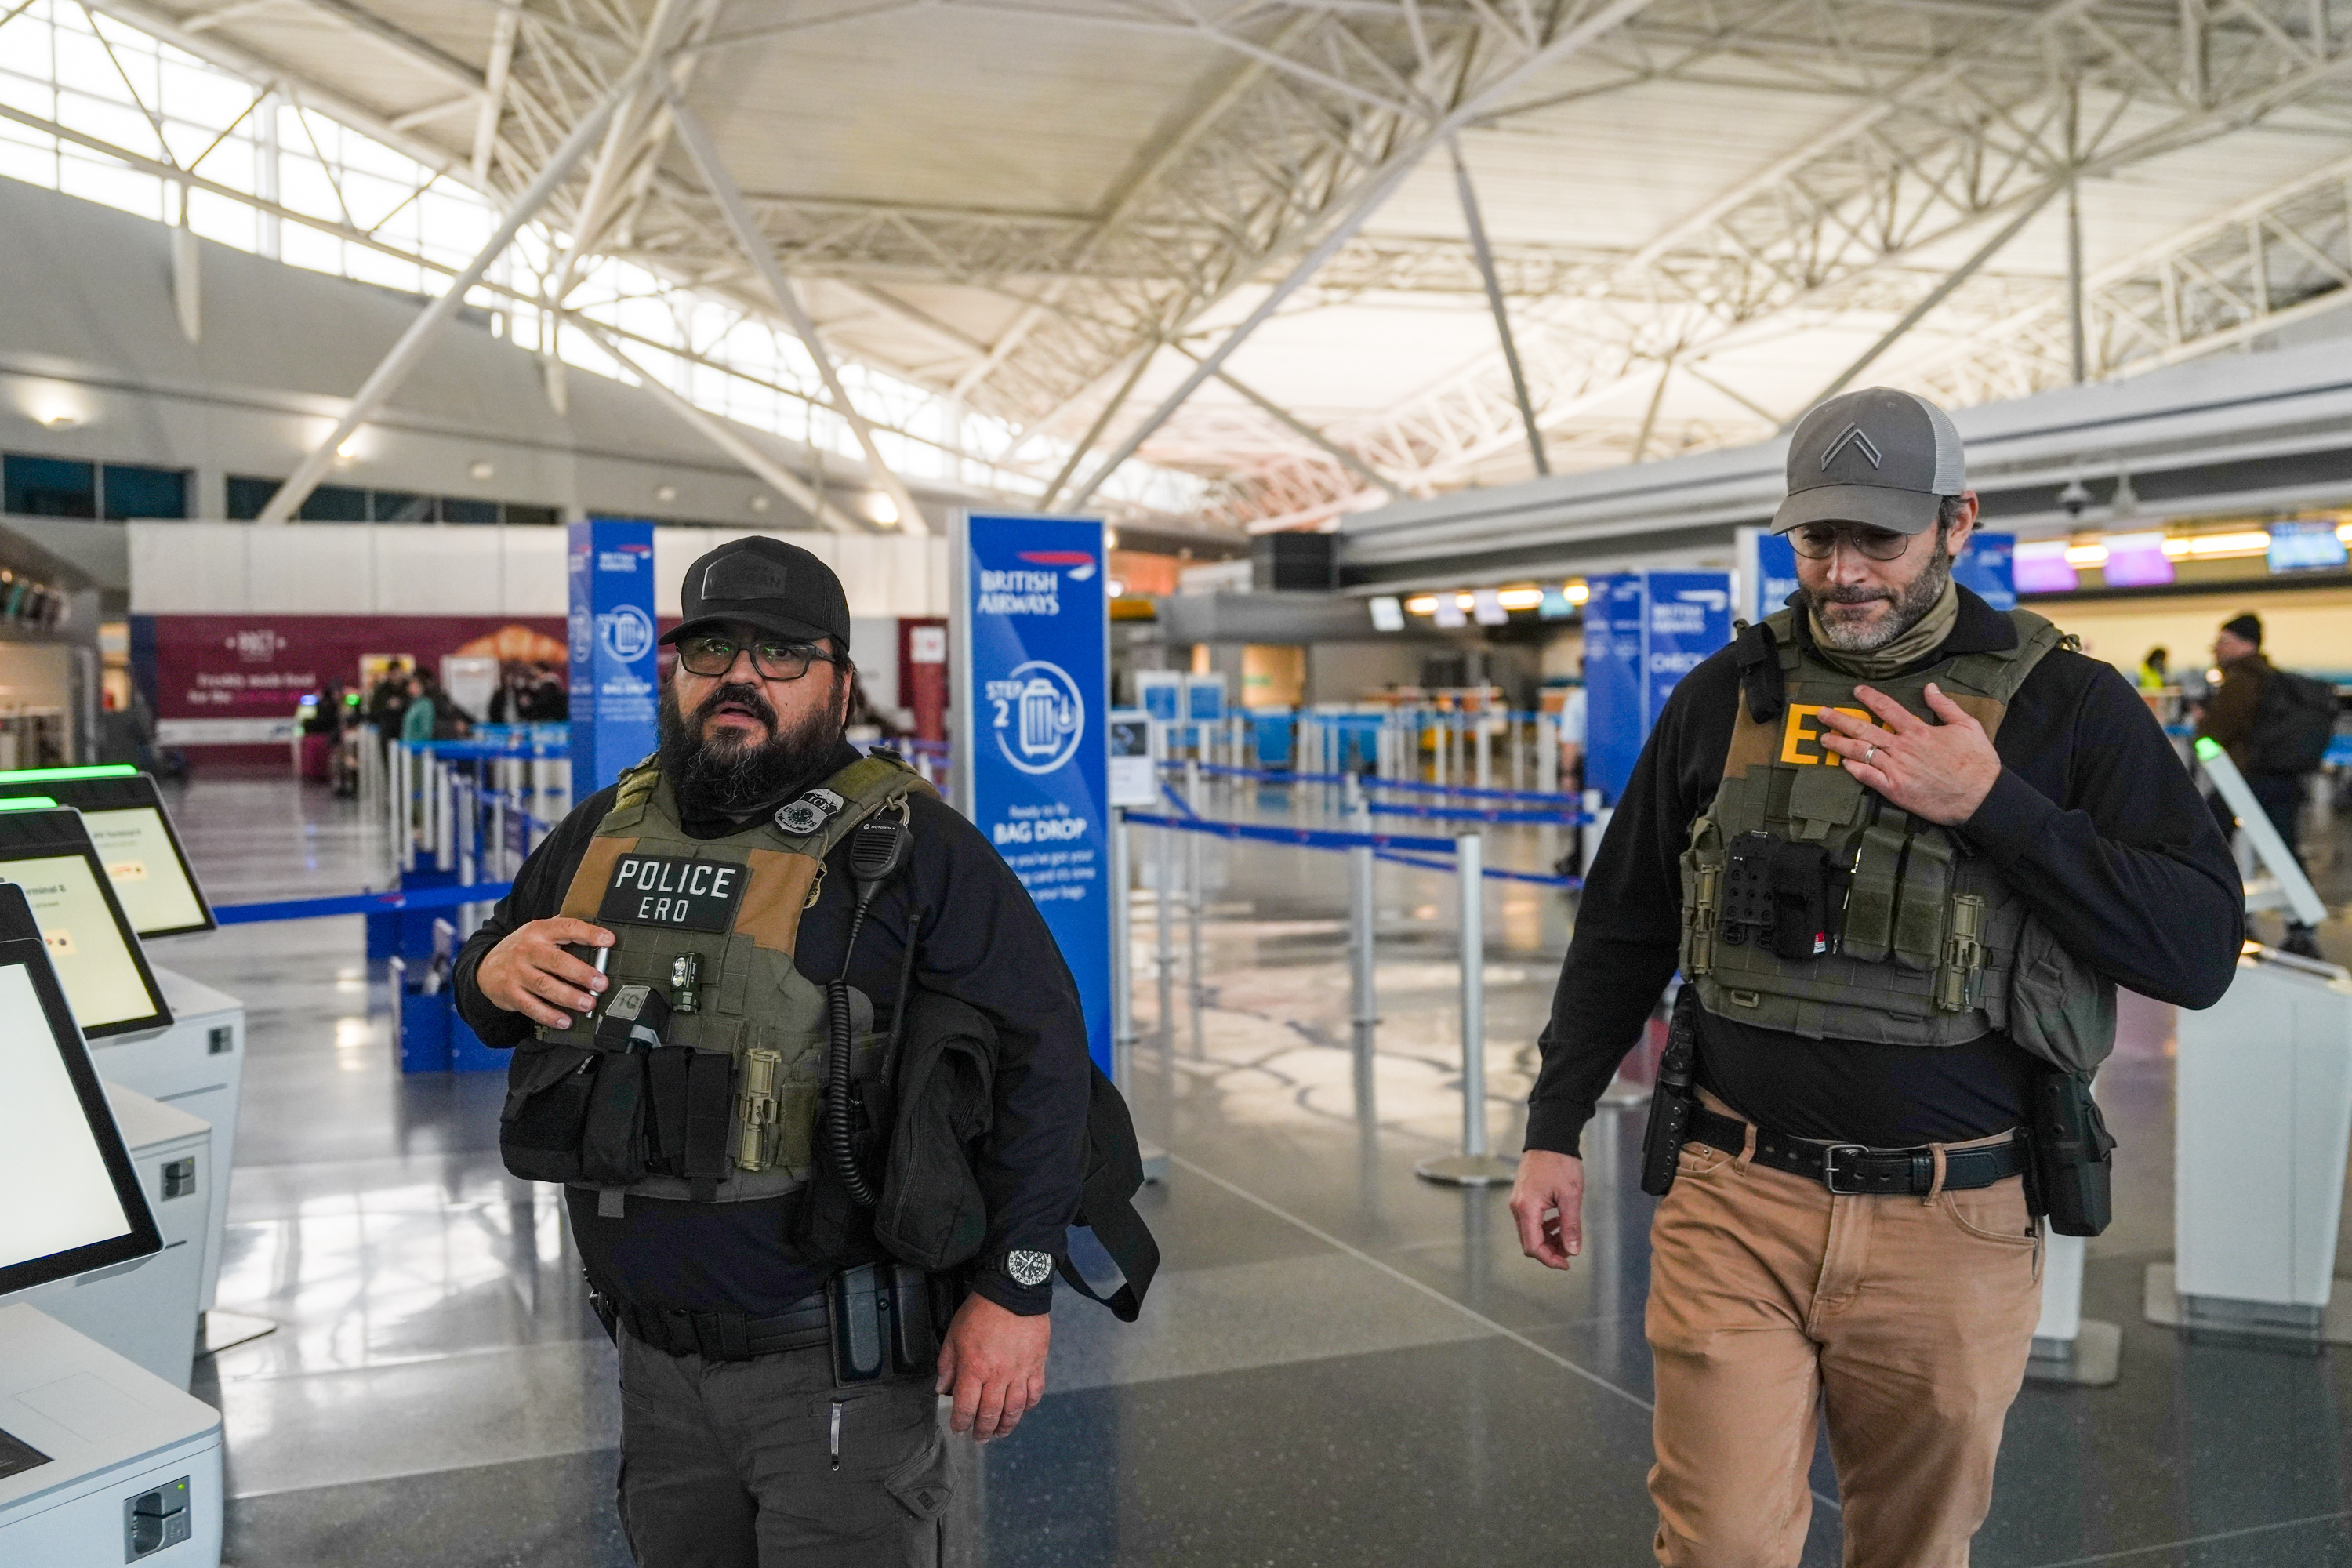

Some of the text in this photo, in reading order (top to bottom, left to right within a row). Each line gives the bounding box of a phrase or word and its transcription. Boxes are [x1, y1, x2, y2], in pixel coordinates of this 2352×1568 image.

[980, 570, 1058, 592] BRITISH
[977, 593, 1059, 615] AIRWAYS
[985, 680, 1024, 700] STEP
[993, 698, 1010, 728] 2
[808, 796, 830, 810] ICE
[993, 818, 1087, 845] BAG DROP
[615, 859, 736, 898] POLICE
[637, 896, 689, 924] ERO
